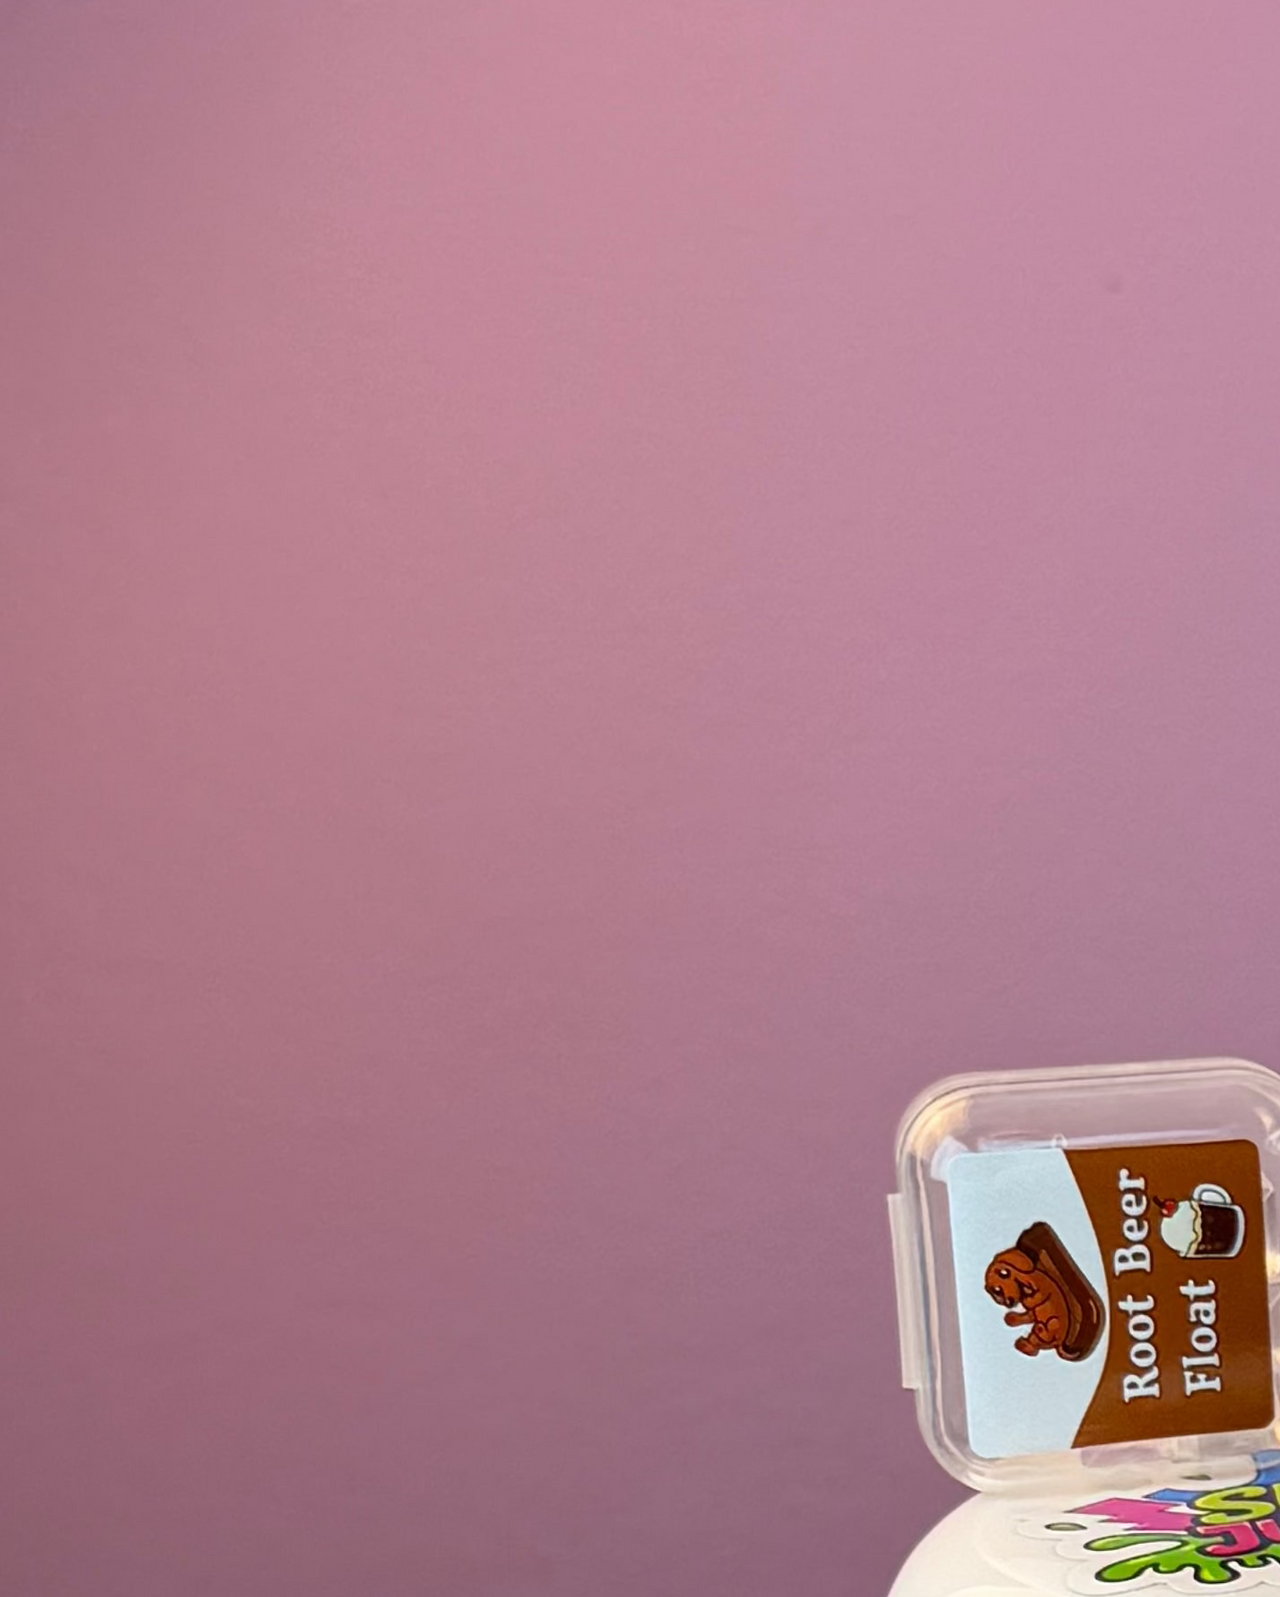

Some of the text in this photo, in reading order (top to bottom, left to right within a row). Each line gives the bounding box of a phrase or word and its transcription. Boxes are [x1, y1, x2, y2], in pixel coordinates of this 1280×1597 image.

[1112, 1168, 1160, 1404] Root Beer
[1179, 1278, 1224, 1397] Float
